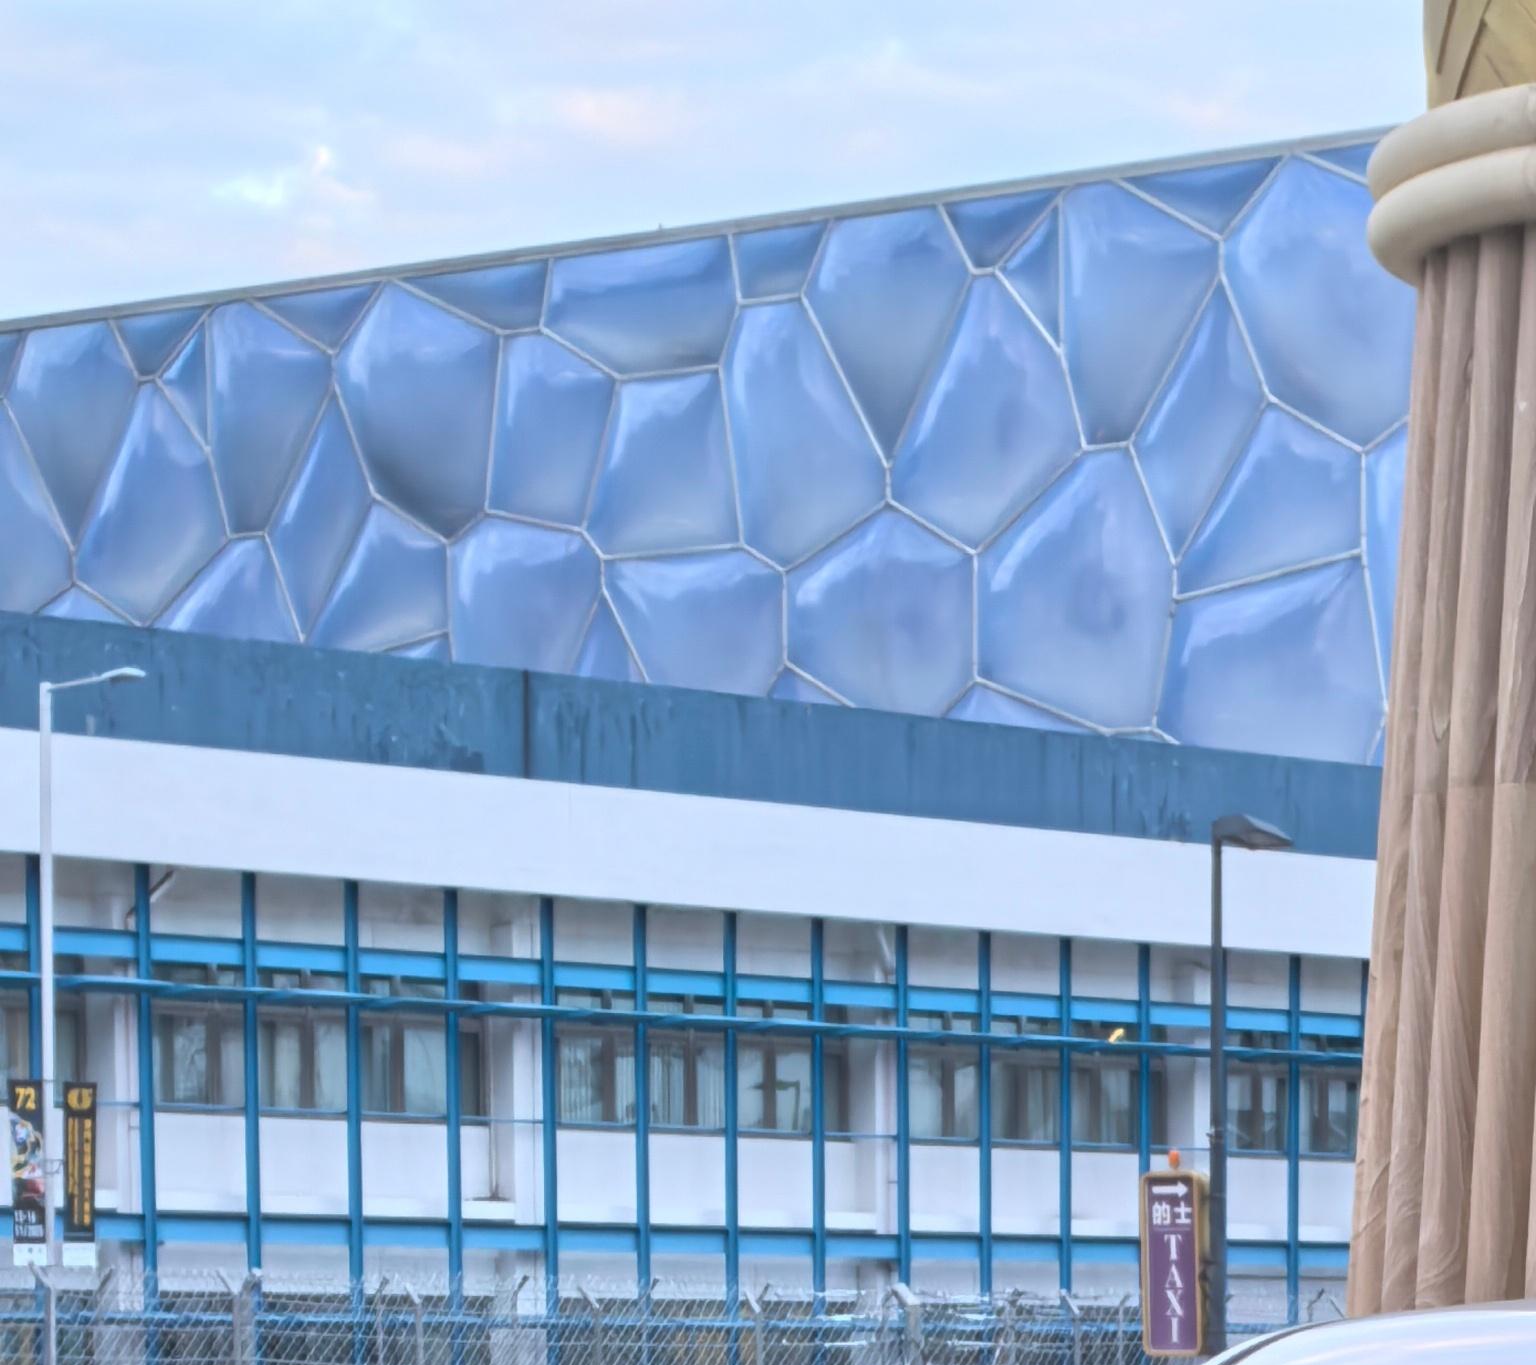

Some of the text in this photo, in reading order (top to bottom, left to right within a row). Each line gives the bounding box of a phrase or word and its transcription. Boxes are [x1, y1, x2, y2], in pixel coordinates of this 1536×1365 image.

[14, 1086, 37, 1111] 72
[1152, 1202, 1193, 1226] 的士
[1164, 1233, 1184, 1344] TAXI
